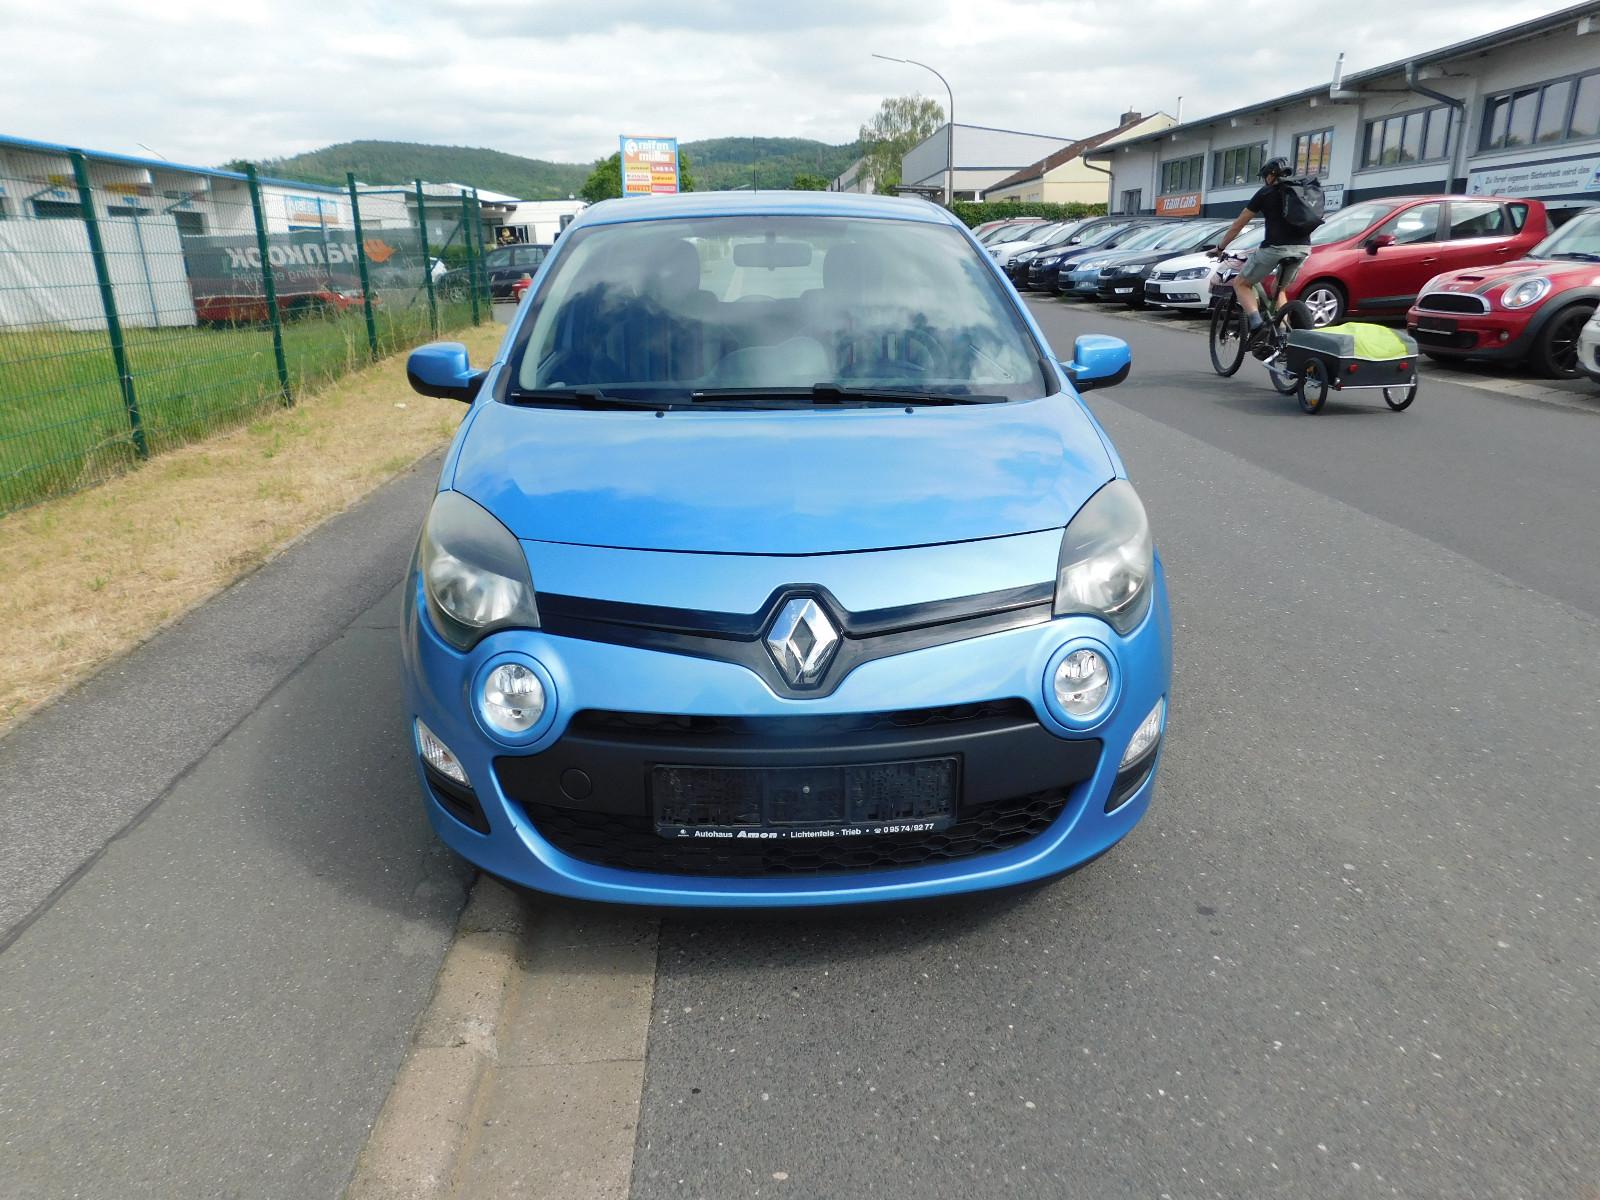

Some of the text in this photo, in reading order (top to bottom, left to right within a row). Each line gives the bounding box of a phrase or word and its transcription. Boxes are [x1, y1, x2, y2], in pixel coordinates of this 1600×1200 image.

[694, 830, 733, 838] Autohaus
[737, 830, 778, 838] Amon
[790, 829, 834, 838] Lichtenfels
[841, 828, 861, 836] Trieb
